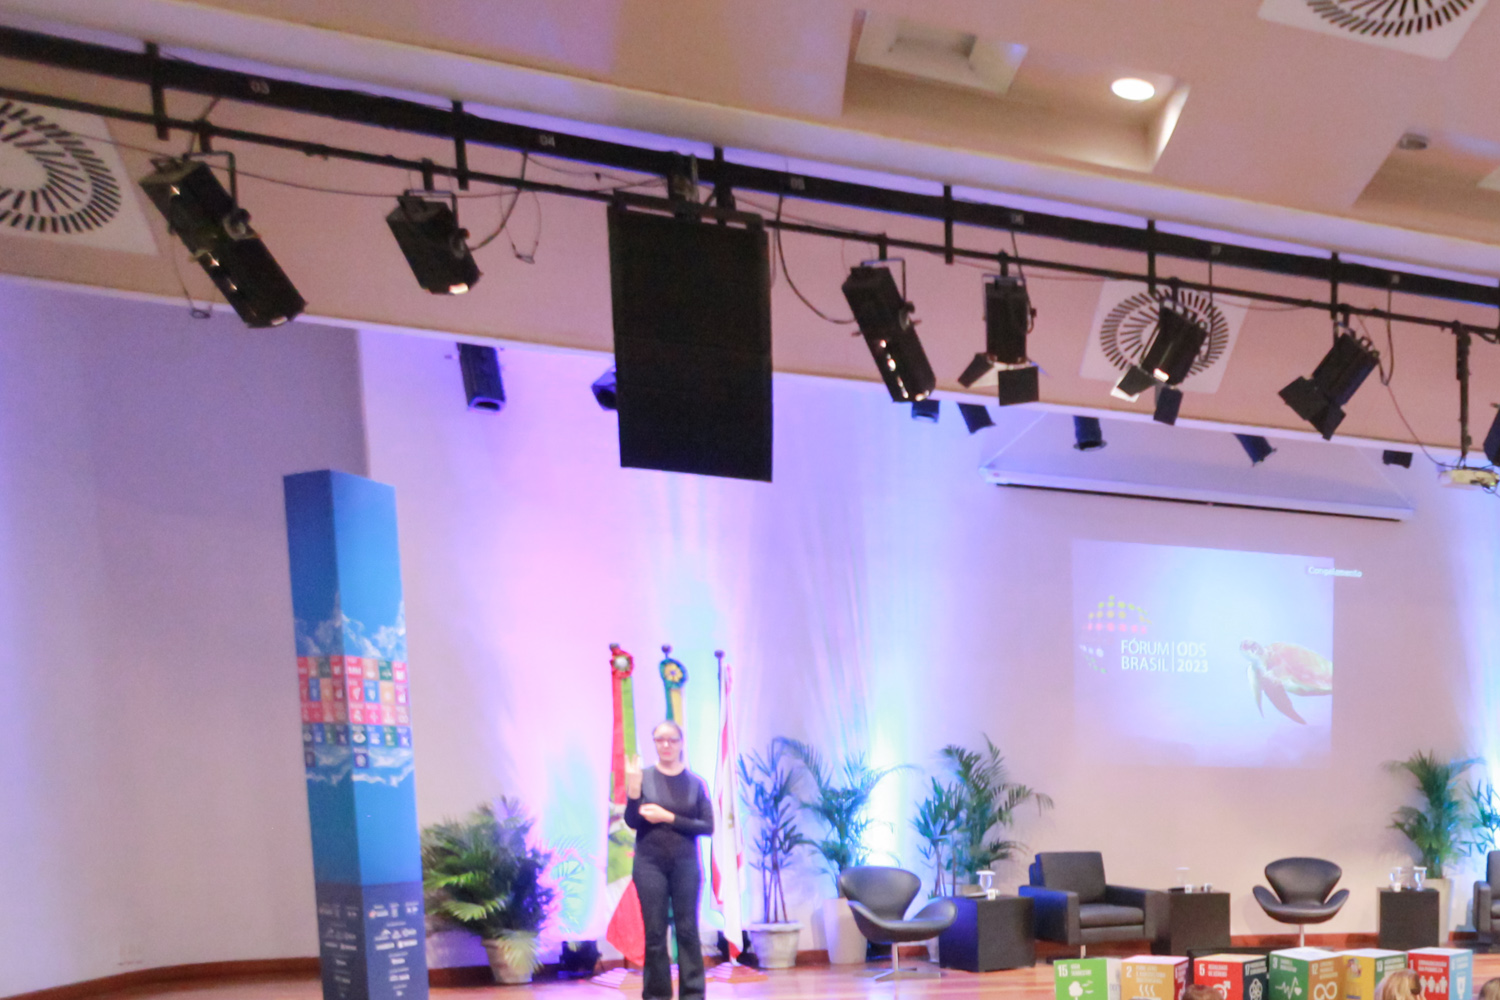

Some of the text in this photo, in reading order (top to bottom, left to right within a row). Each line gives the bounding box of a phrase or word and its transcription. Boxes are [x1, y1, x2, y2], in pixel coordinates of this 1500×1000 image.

[1121, 638, 1207, 657] FÓRUM ODS
[1121, 657, 1208, 673] BRASIL 2023
[1057, 964, 1068, 977] 15
[1126, 965, 1132, 978] 2
